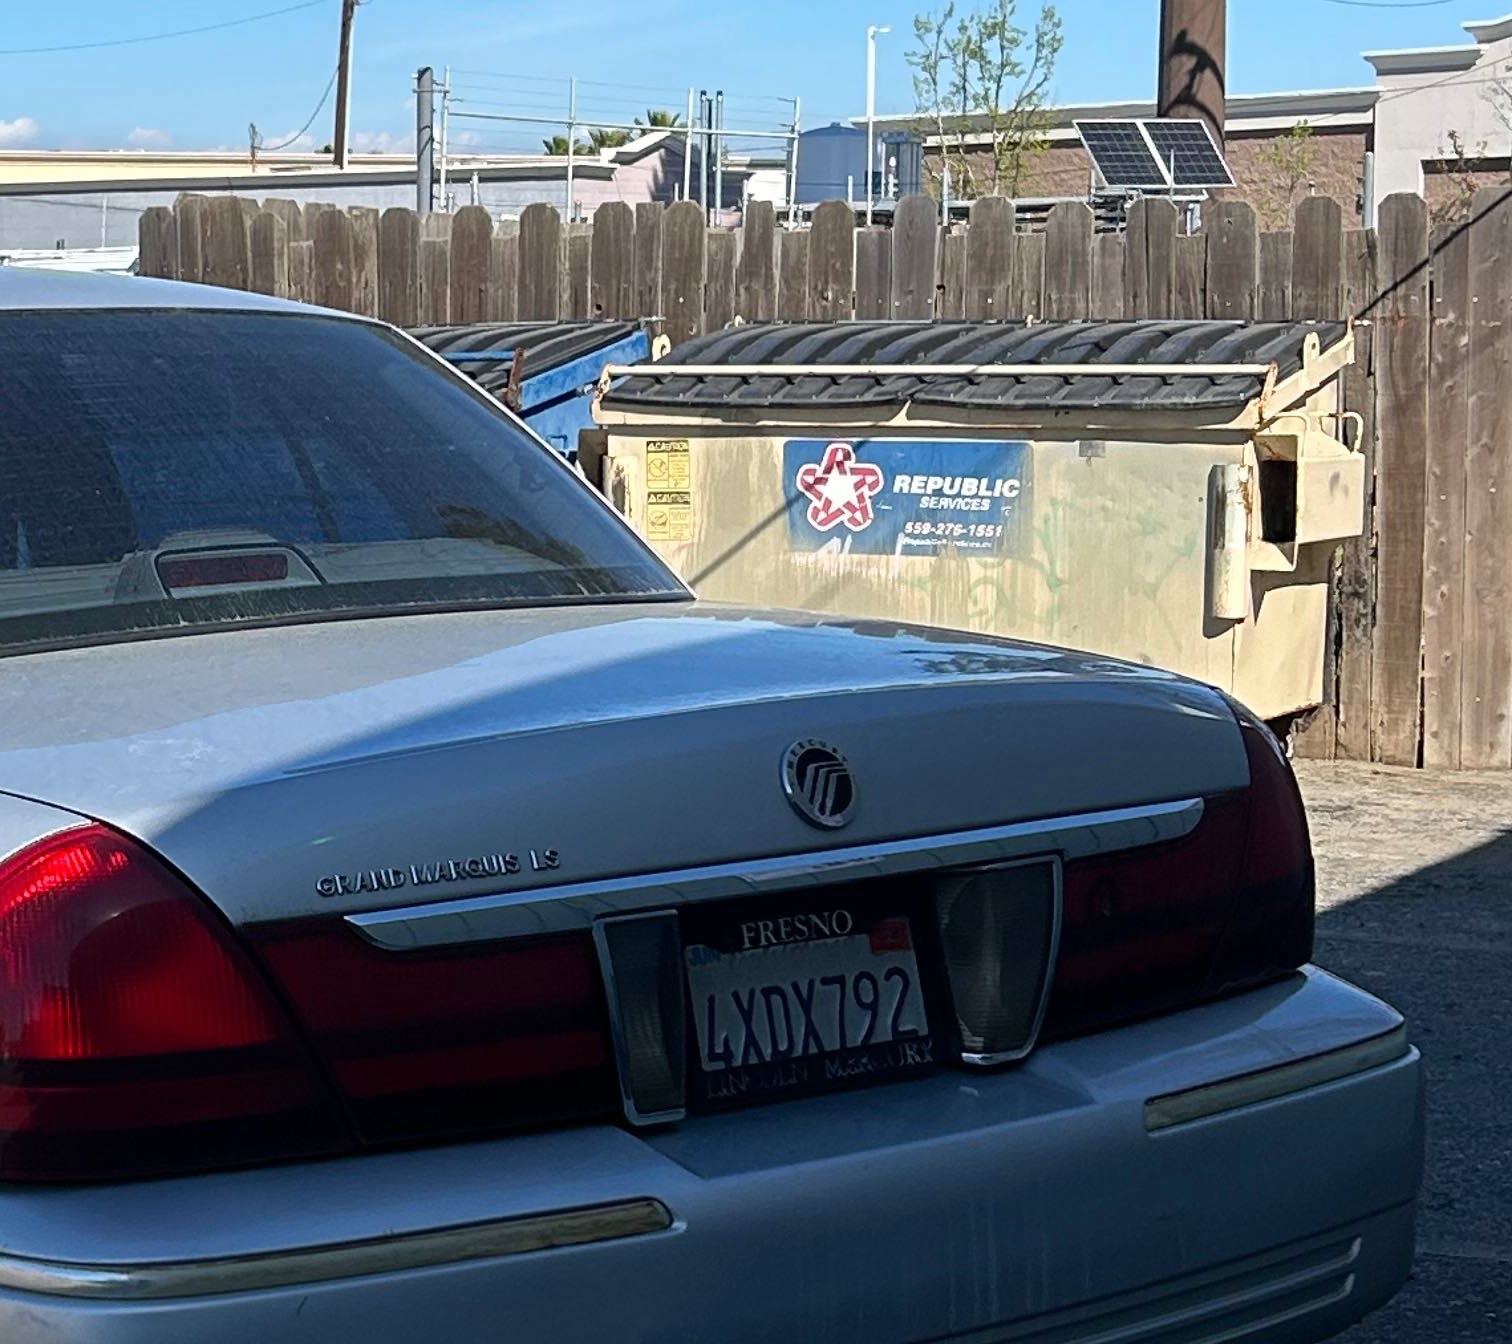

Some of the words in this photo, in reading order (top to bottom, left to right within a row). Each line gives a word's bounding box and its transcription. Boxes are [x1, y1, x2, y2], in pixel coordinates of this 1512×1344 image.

[892, 474, 1022, 498] REPUBLIC
[919, 496, 991, 511] SERVICES
[316, 867, 405, 896] GRAND
[409, 852, 520, 885] MARQUIS
[529, 848, 561, 872] LS
[740, 909, 854, 949] FRESNO
[705, 965, 920, 1065] 4XDX792
